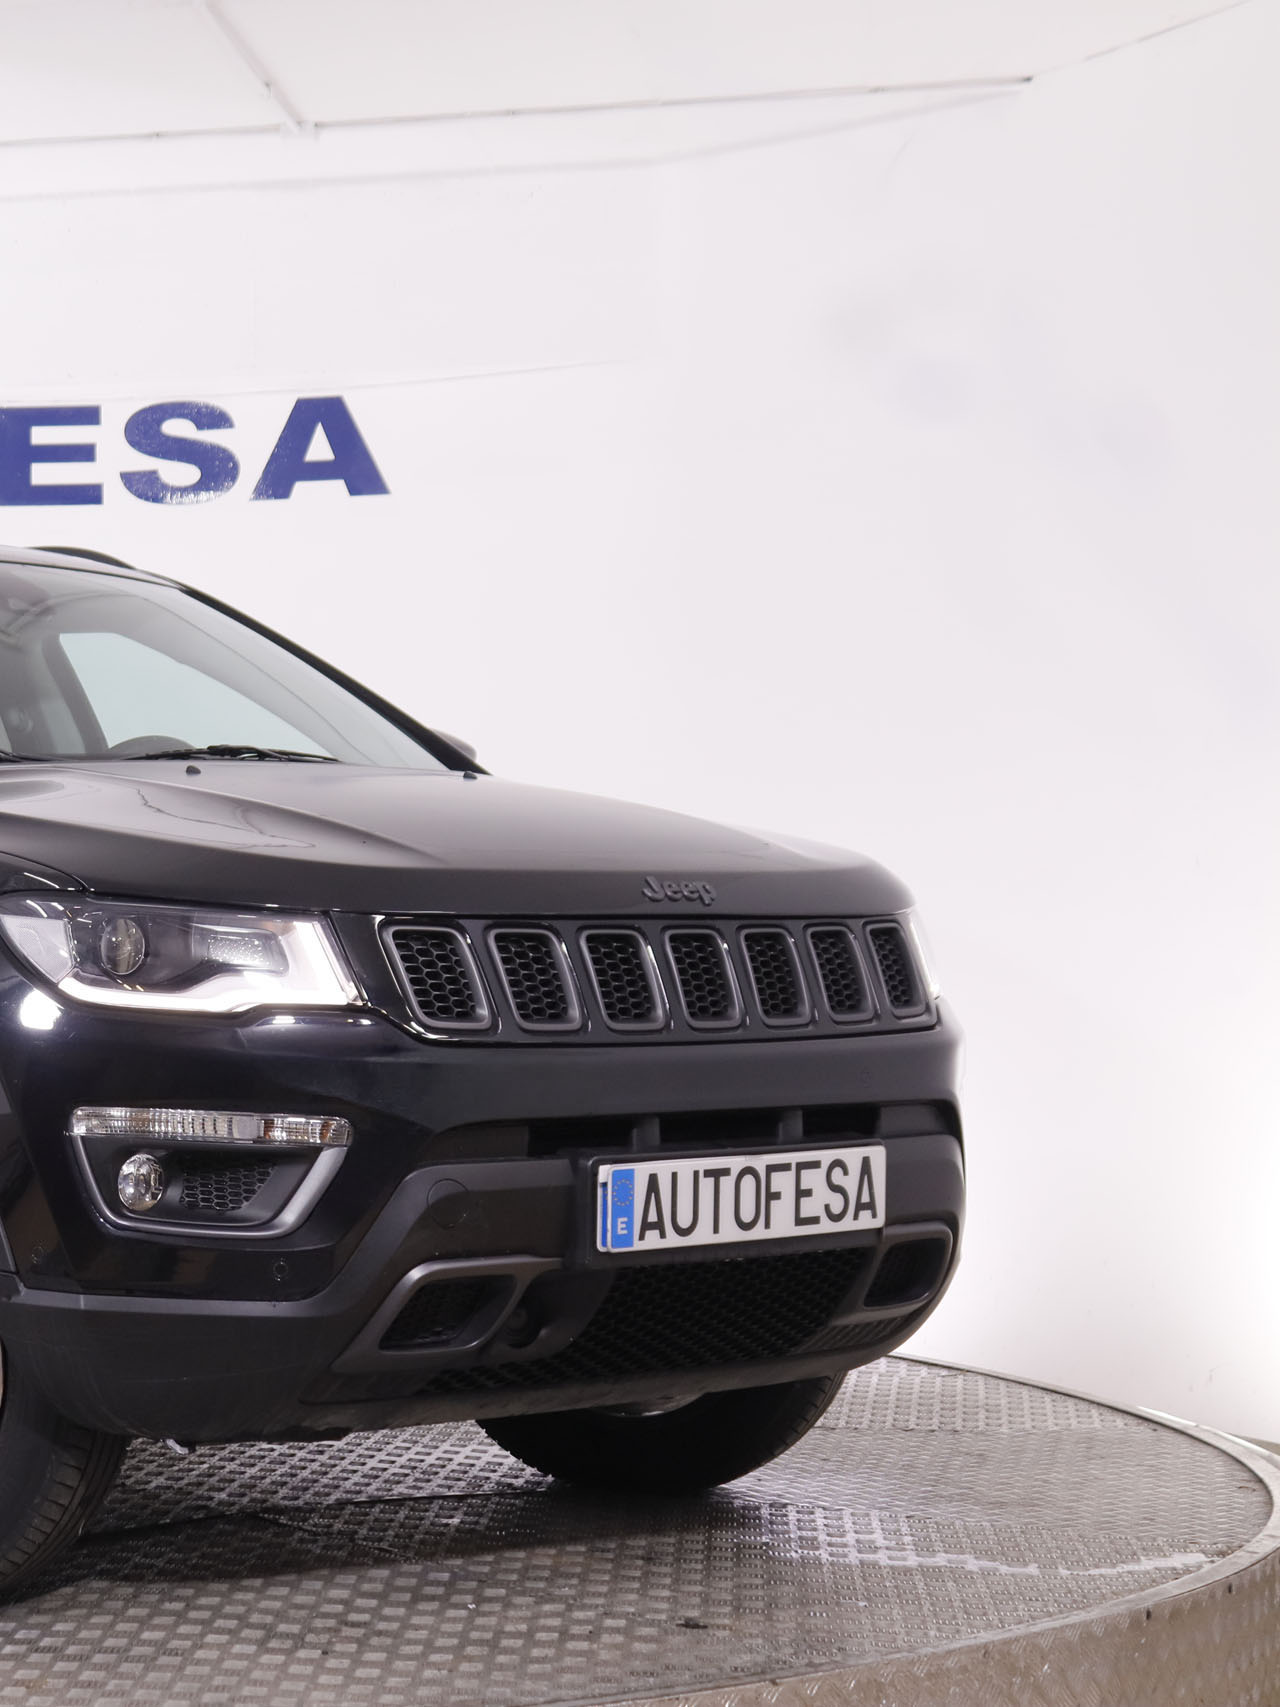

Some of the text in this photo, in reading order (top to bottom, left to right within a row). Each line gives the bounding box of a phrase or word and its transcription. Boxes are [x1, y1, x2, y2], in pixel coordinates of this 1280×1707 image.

[642, 876, 717, 906] Jeep
[638, 1156, 877, 1241] AUTOFESA
[617, 1218, 627, 1234] E
